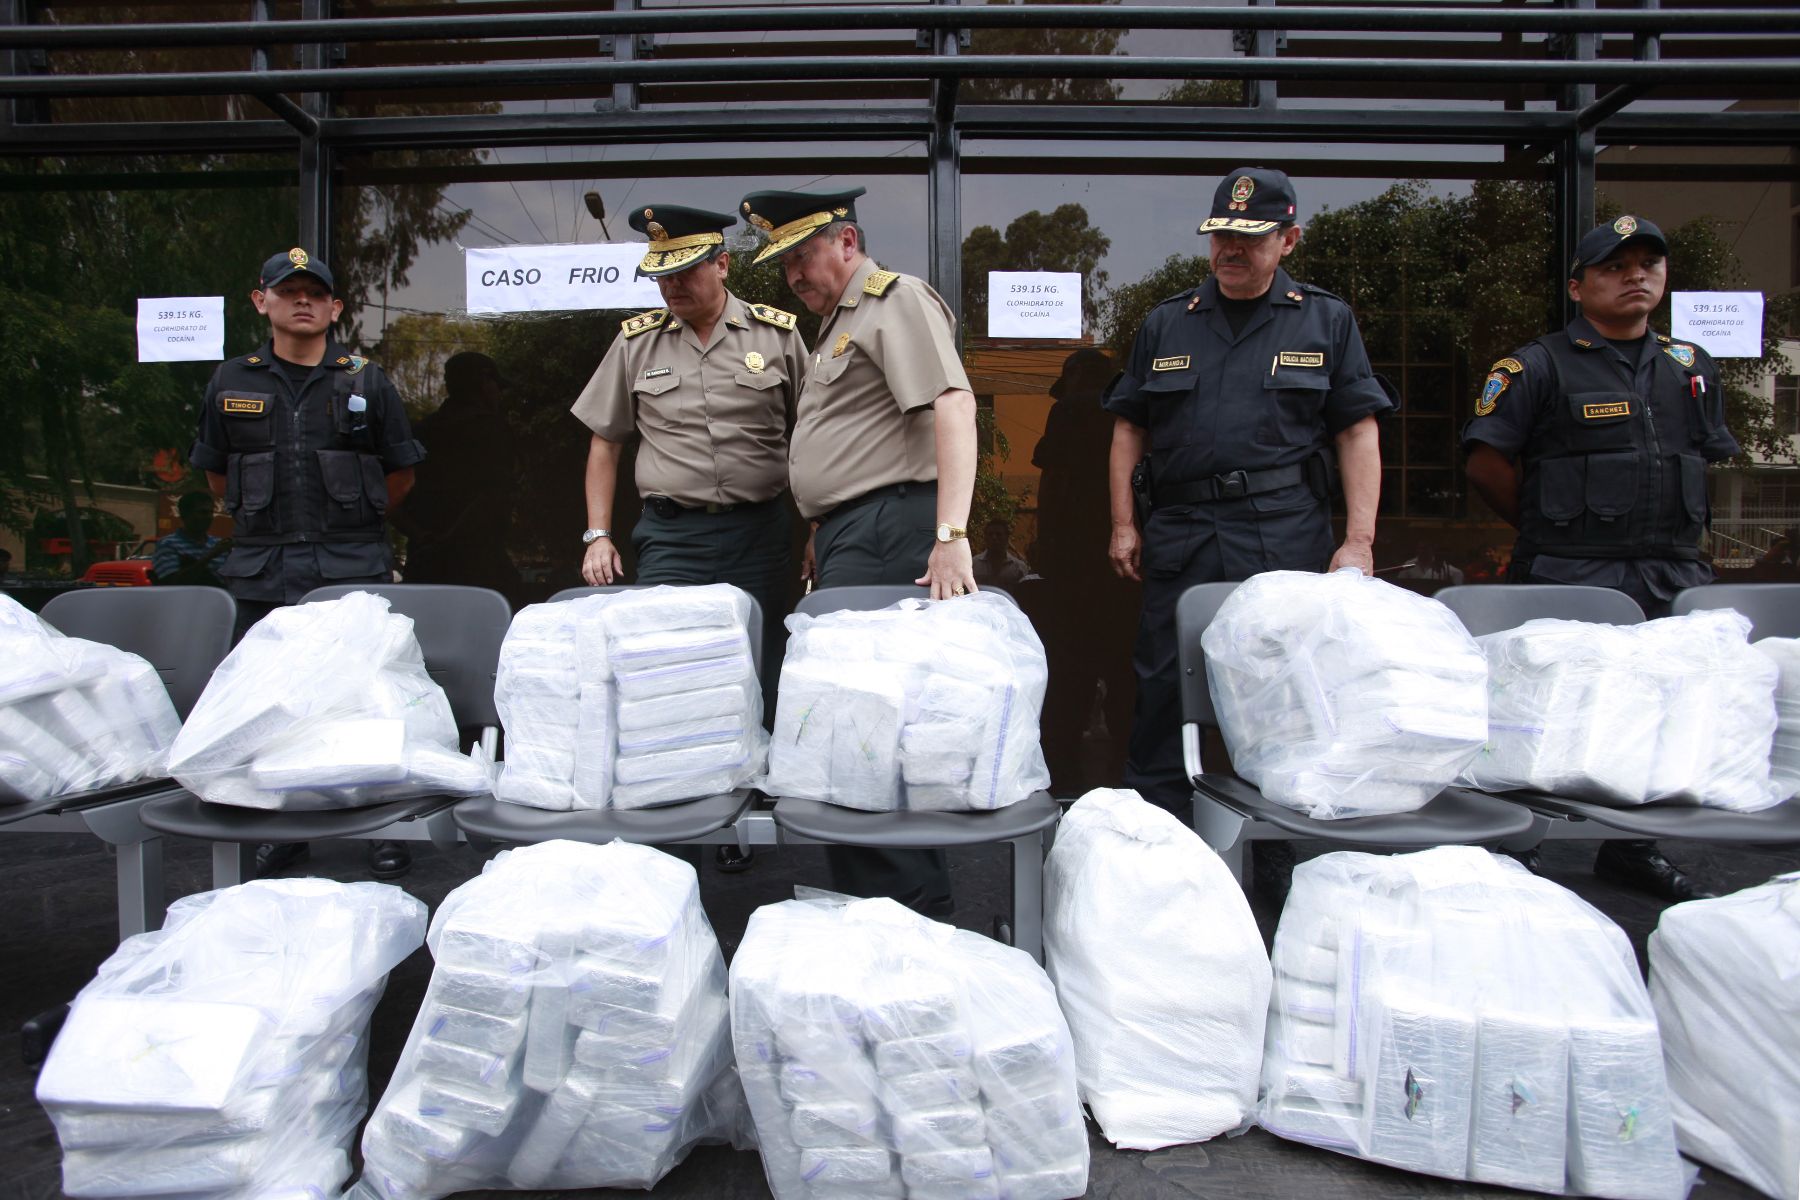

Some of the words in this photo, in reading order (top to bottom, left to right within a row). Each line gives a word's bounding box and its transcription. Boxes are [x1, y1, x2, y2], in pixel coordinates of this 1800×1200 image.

[481, 268, 541, 287] CASO
[568, 266, 620, 285] FRIO
[1010, 284, 1042, 293] 539.15
[1044, 285, 1059, 294] KG.
[1692, 304, 1723, 313] 539.15
[1725, 304, 1740, 313] KG.
[158, 310, 187, 320] 539.15
[189, 310, 204, 319] KG.
[1020, 310, 1050, 318] COCAÍNA
[1158, 359, 1184, 368] MIRANDA
[1590, 406, 1623, 415] SANCHEZ
